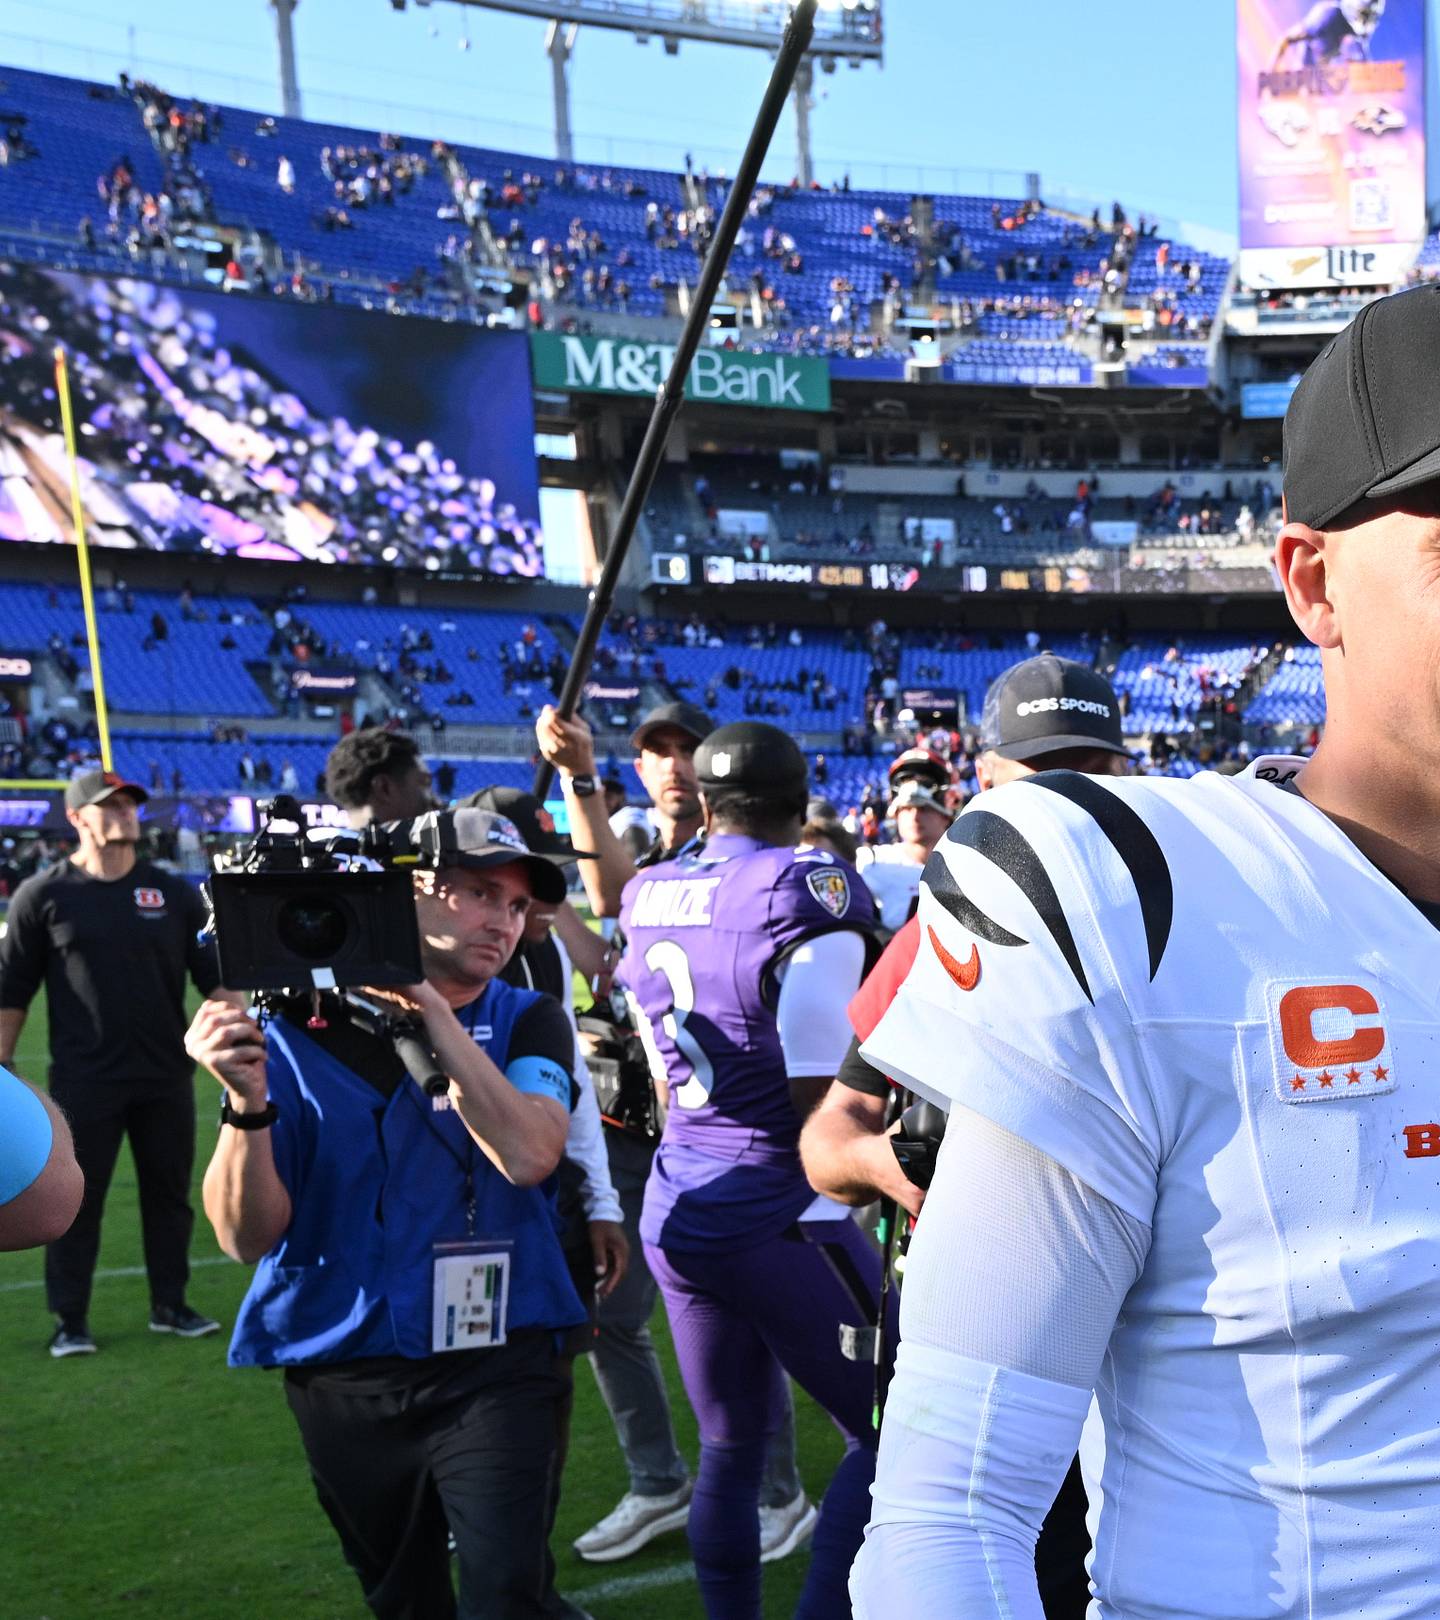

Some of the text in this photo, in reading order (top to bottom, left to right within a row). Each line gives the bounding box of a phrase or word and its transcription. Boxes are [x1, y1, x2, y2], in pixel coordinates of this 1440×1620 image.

[1325, 246, 1376, 281] Lite
[690, 350, 804, 404] Bank
[1060, 697, 1110, 718] SPORTS
[1280, 984, 1385, 1068] C
[432, 1096, 456, 1112] NF
